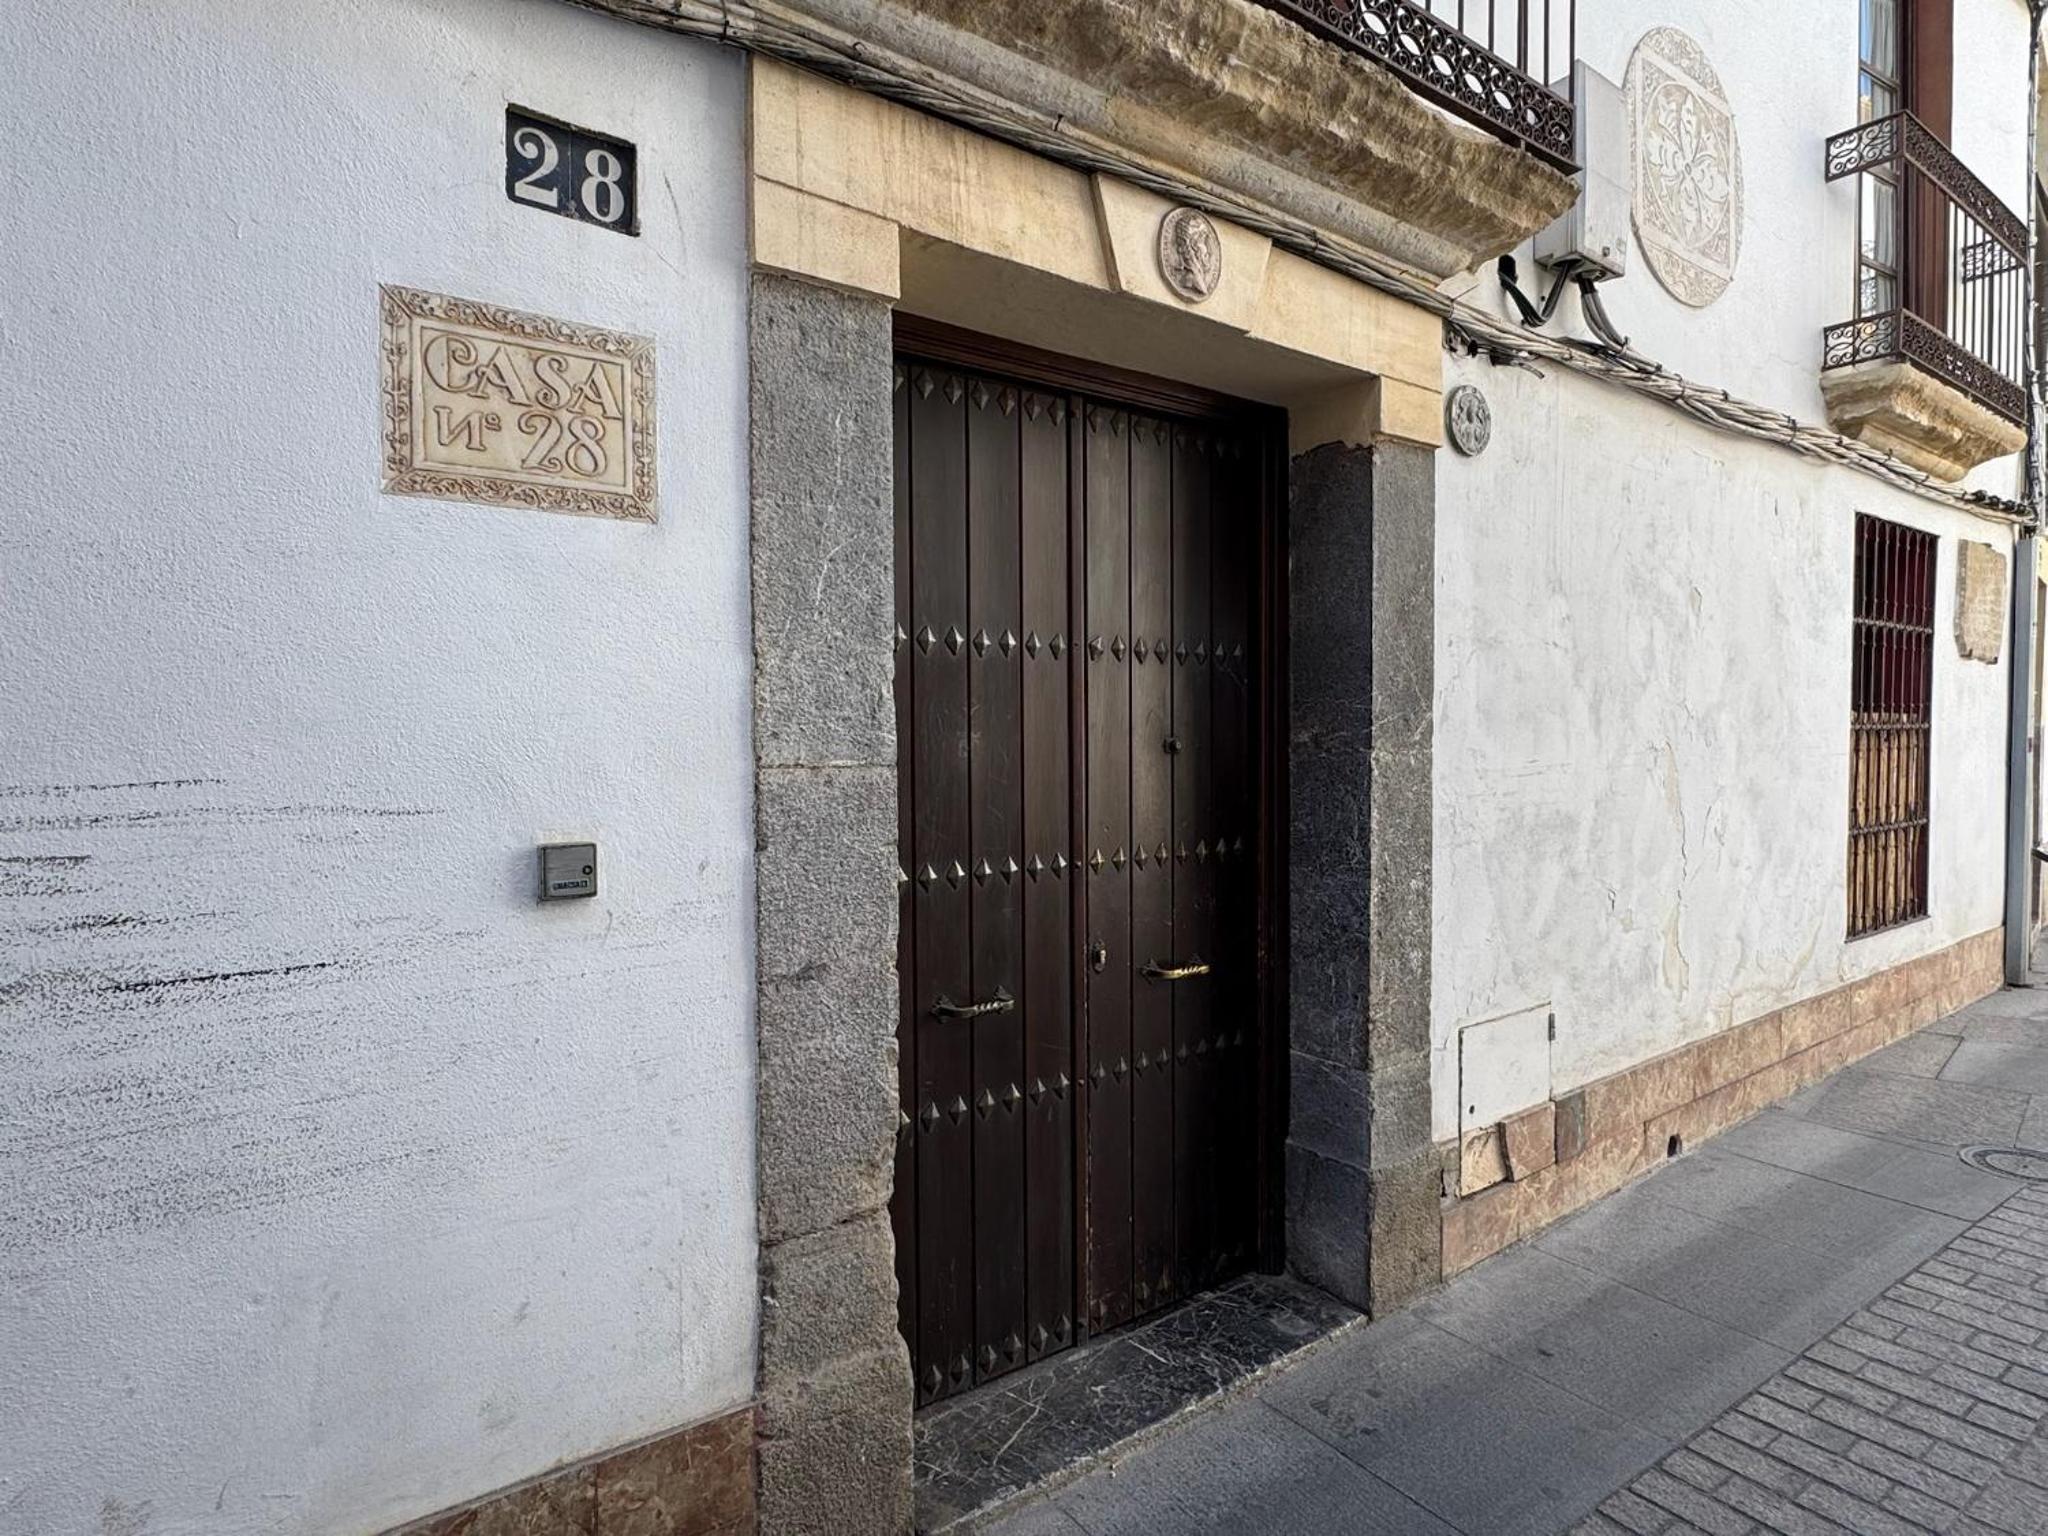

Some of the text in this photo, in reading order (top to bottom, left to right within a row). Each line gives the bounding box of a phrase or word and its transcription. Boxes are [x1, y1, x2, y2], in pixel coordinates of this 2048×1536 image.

[513, 127, 625, 223] 28
[424, 332, 623, 420] CASA
[518, 410, 608, 478] 28
